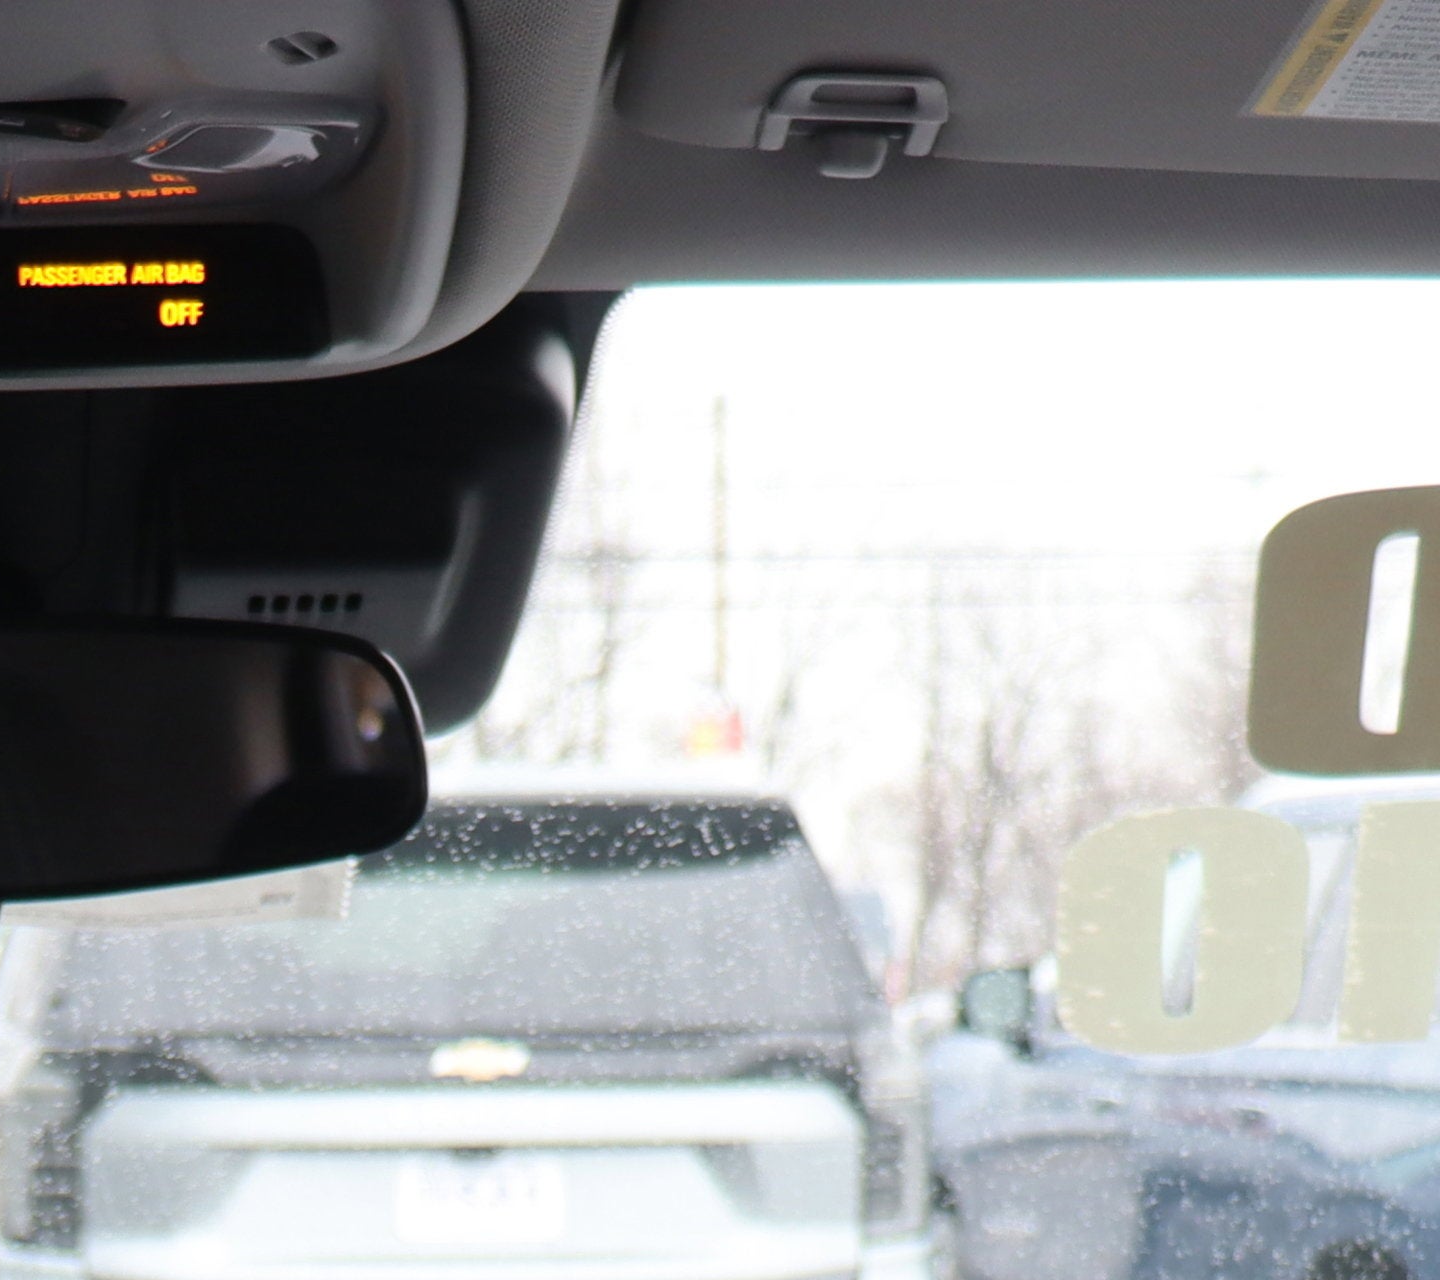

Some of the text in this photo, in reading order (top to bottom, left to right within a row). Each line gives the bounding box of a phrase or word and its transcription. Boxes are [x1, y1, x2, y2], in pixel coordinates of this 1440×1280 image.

[19, 263, 205, 286] PASSENGER AIR BAG
[160, 301, 204, 327] OFF
